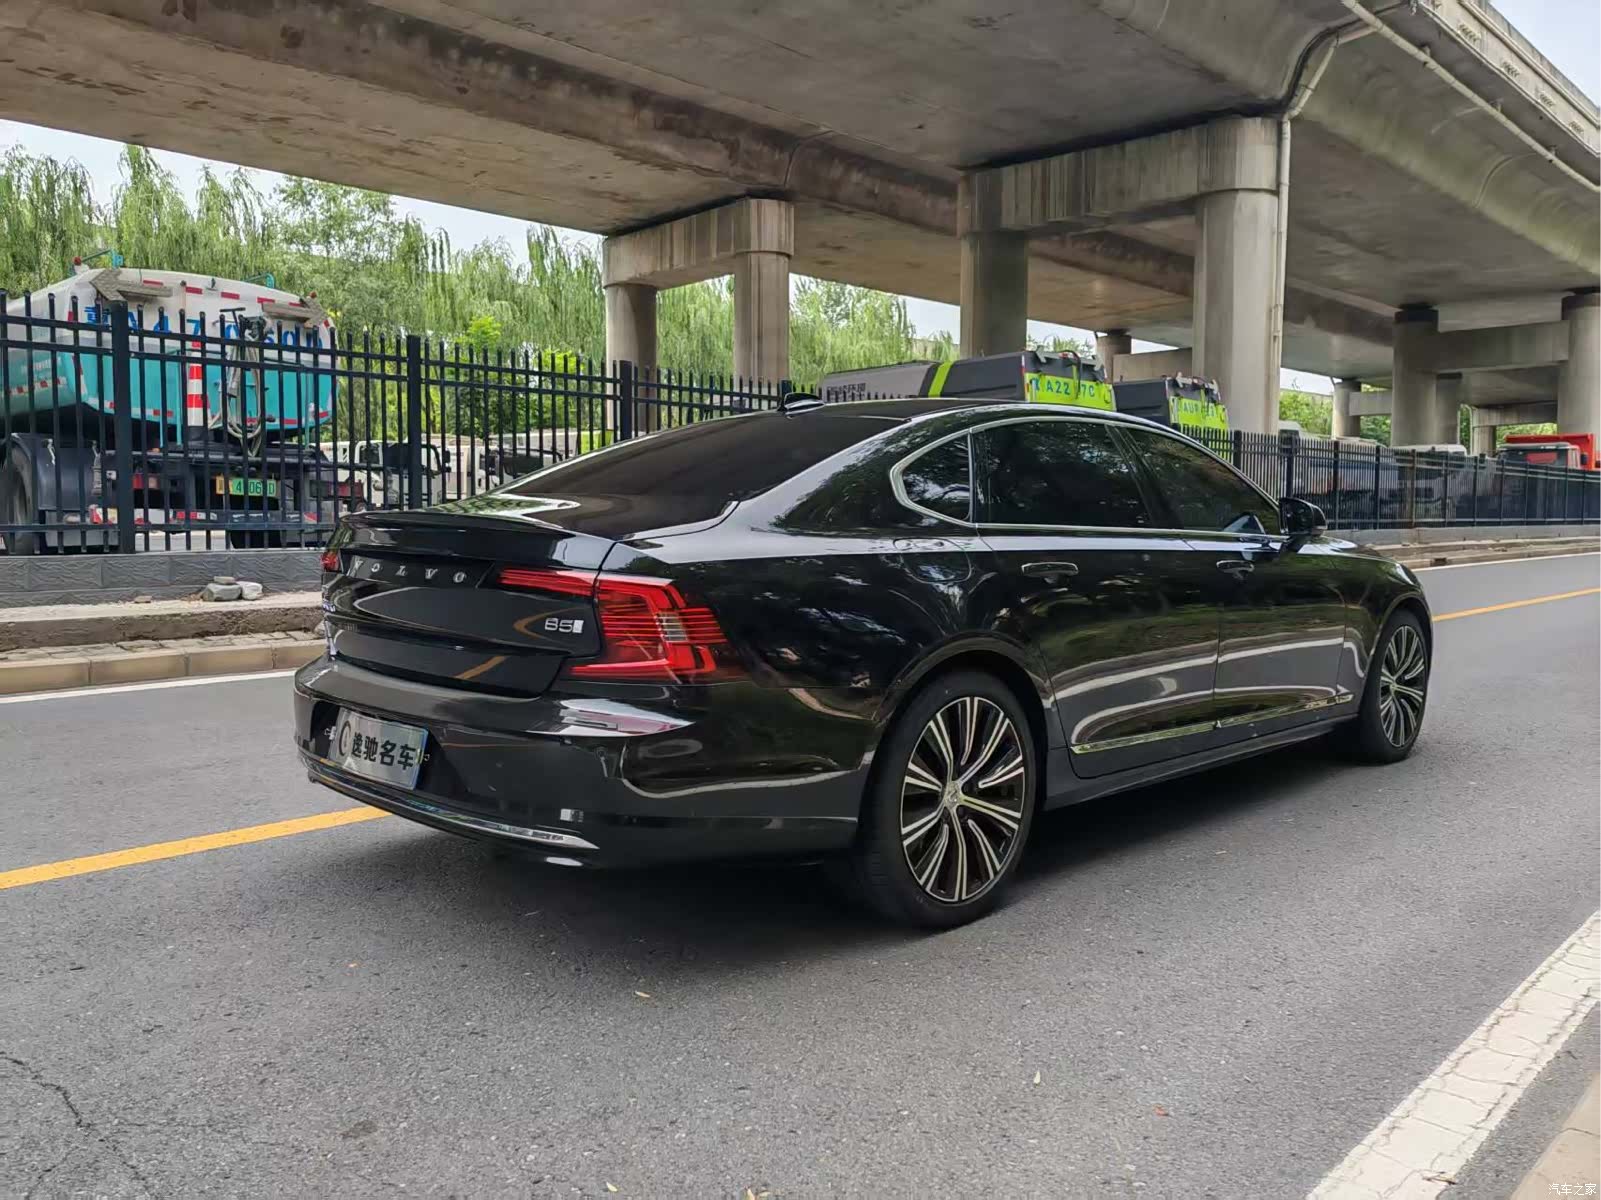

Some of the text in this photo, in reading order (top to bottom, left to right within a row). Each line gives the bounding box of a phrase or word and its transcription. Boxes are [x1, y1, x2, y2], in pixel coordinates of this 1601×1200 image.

[352, 560, 467, 583] VOLVO
[351, 731, 416, 770] 逸驰名车
